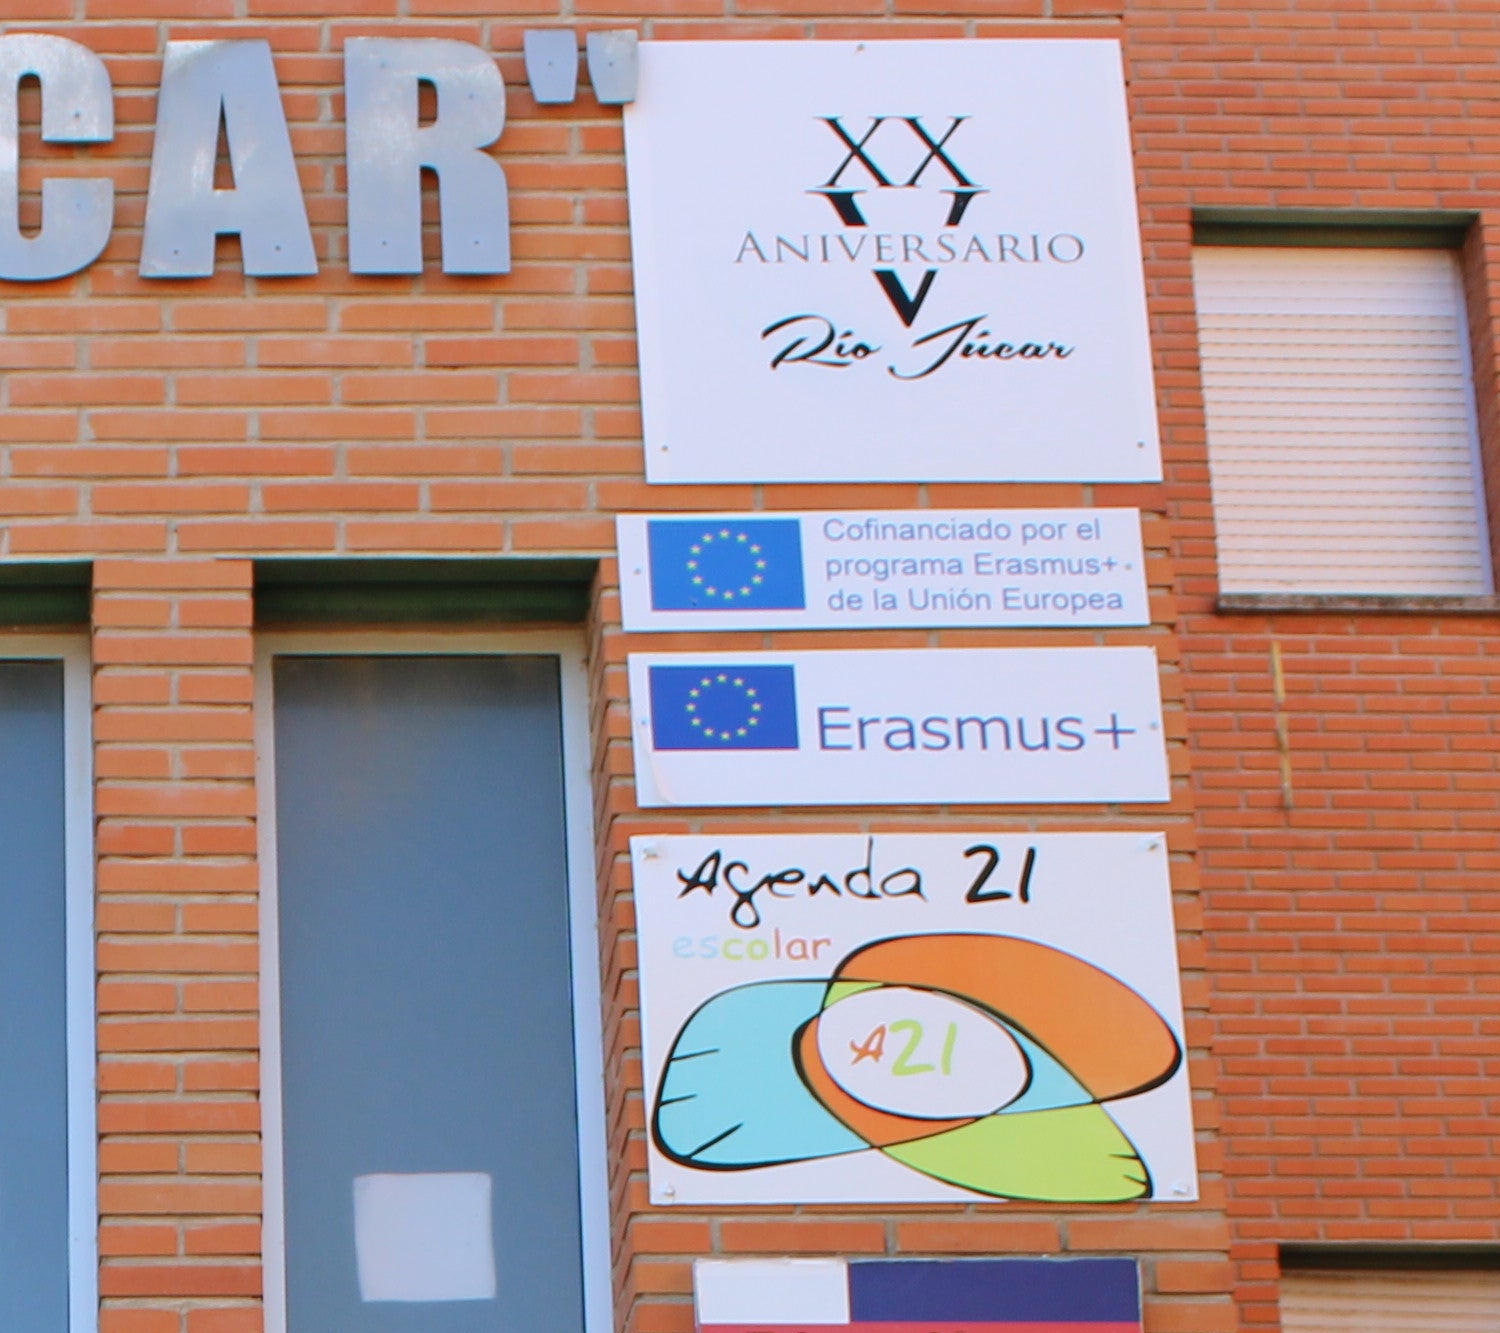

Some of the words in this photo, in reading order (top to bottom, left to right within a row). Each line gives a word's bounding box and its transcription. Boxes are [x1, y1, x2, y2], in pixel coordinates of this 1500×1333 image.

[734, 231, 1086, 263] ANIVERSARIO
[761, 314, 880, 369] Río
[888, 314, 1074, 379] Júcar
[823, 518, 1011, 542] Cofinanciado
[1021, 522, 1066, 548] por
[1077, 518, 1101, 541] el
[826, 558, 962, 581] programa
[975, 554, 1118, 576] Erasmus+
[828, 590, 862, 611] de
[872, 590, 898, 611] la
[909, 589, 991, 611] Unión
[1003, 589, 1122, 616] Europea
[817, 707, 1136, 750] Erasmus+
[677, 836, 927, 928] Agenda
[964, 845, 1035, 903] 21
[672, 928, 832, 962] escolar
[850, 1019, 957, 1077] A21
